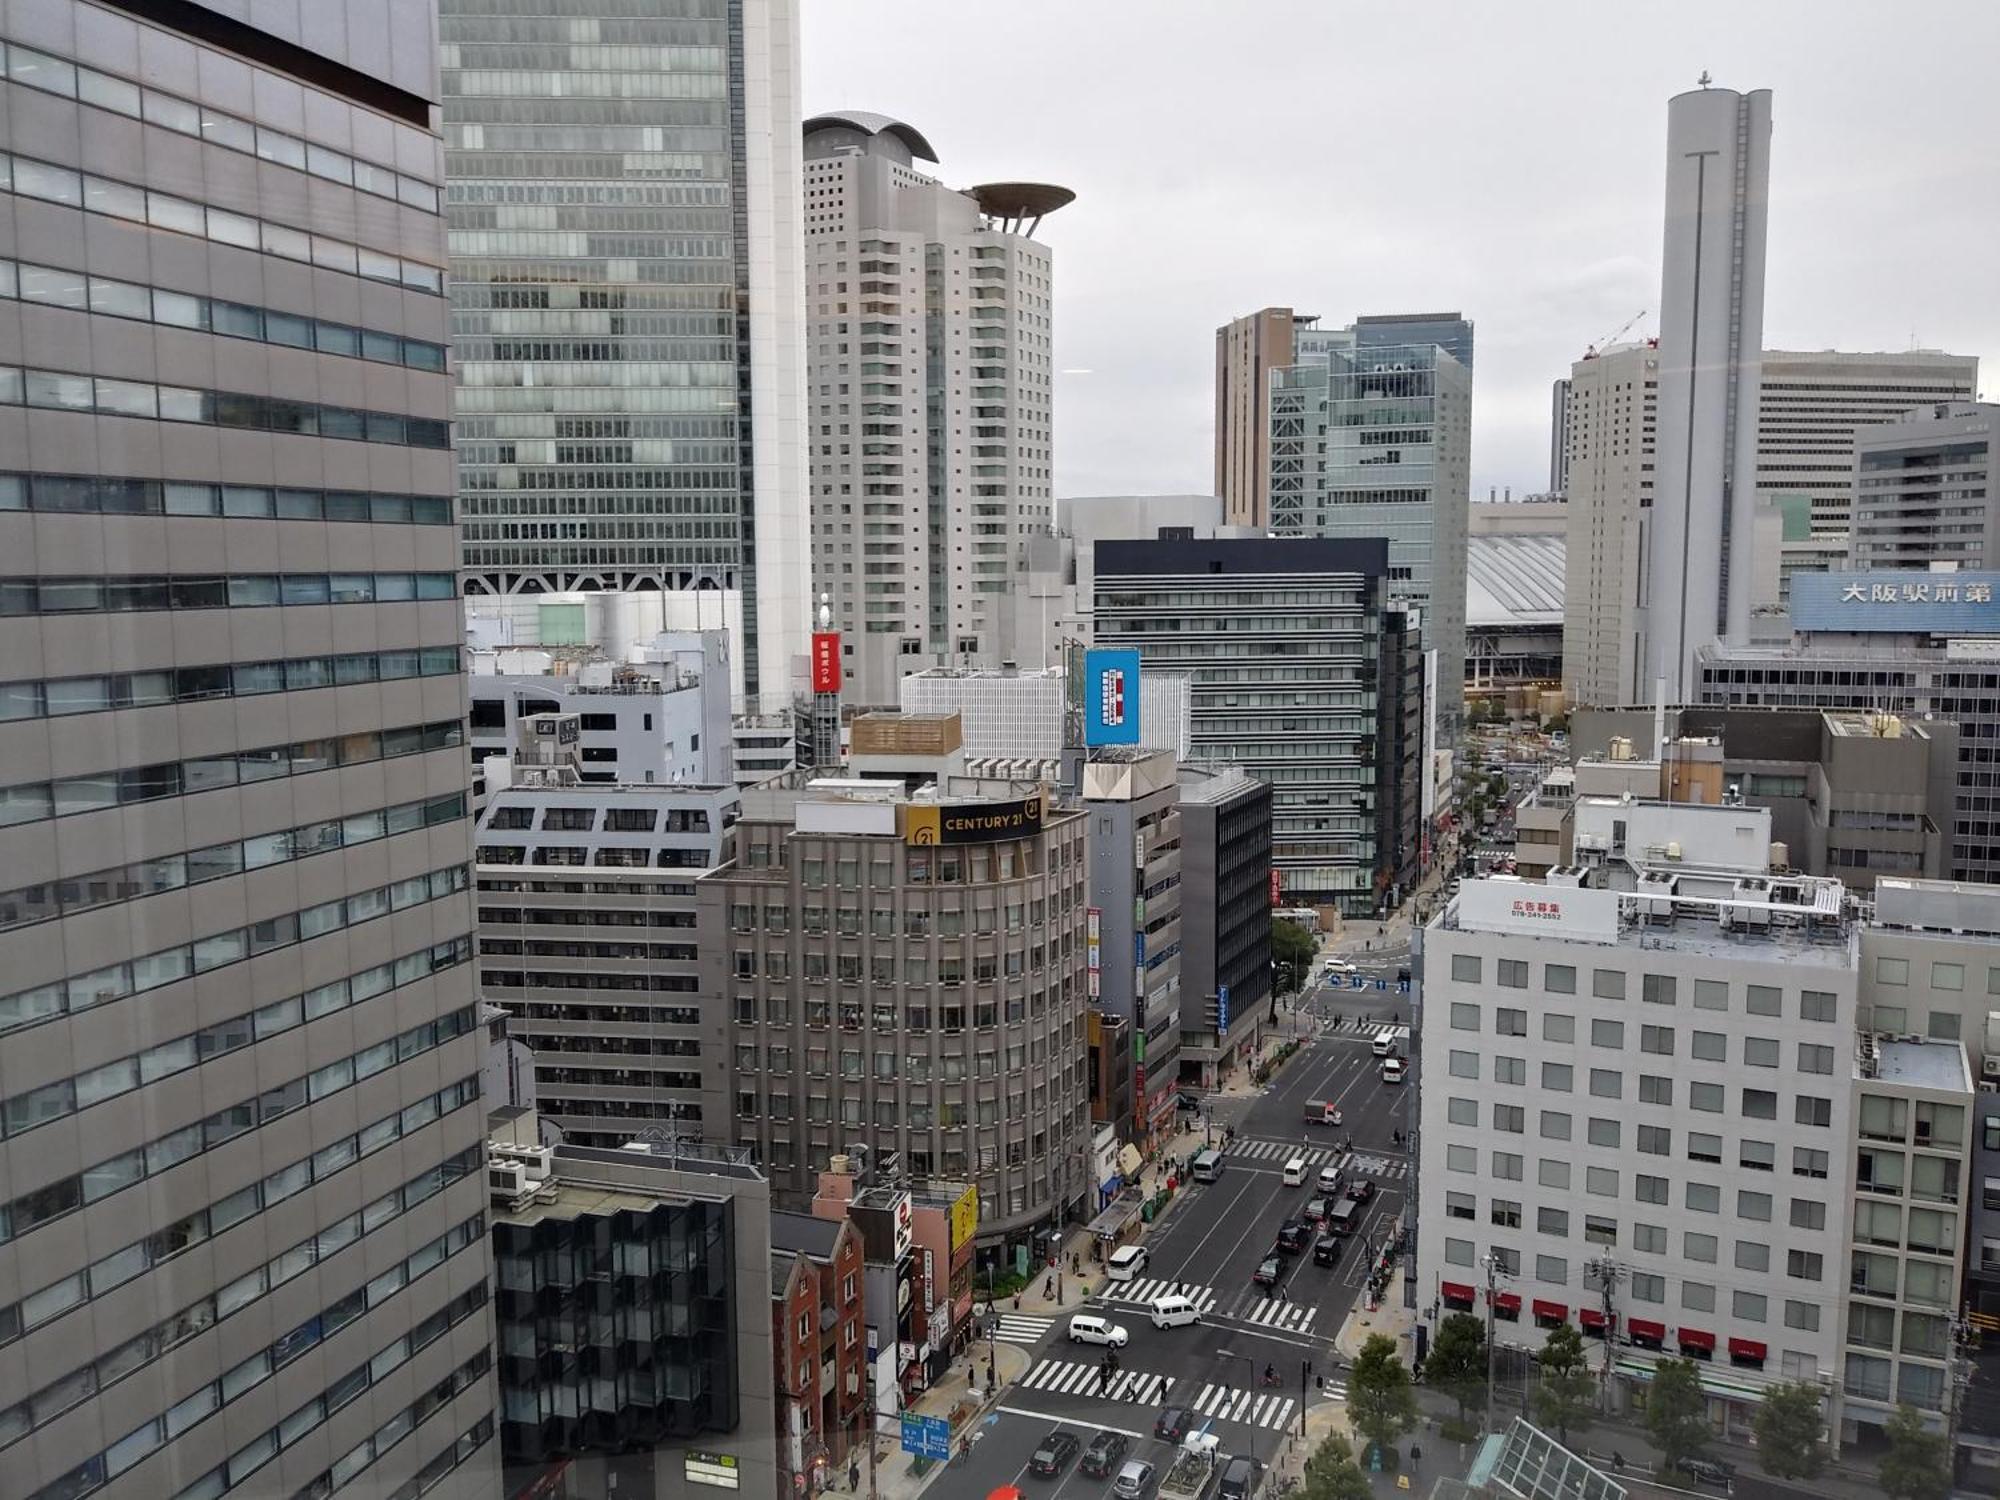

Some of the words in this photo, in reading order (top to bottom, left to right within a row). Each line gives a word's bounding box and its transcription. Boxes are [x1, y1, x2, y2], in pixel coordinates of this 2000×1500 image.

[1841, 583, 1992, 603] 大阪駅前第
[1028, 800, 1038, 814] 21
[945, 815, 1010, 830] CENTURY
[1012, 813, 1023, 826] 21
[921, 832, 933, 845] 21
